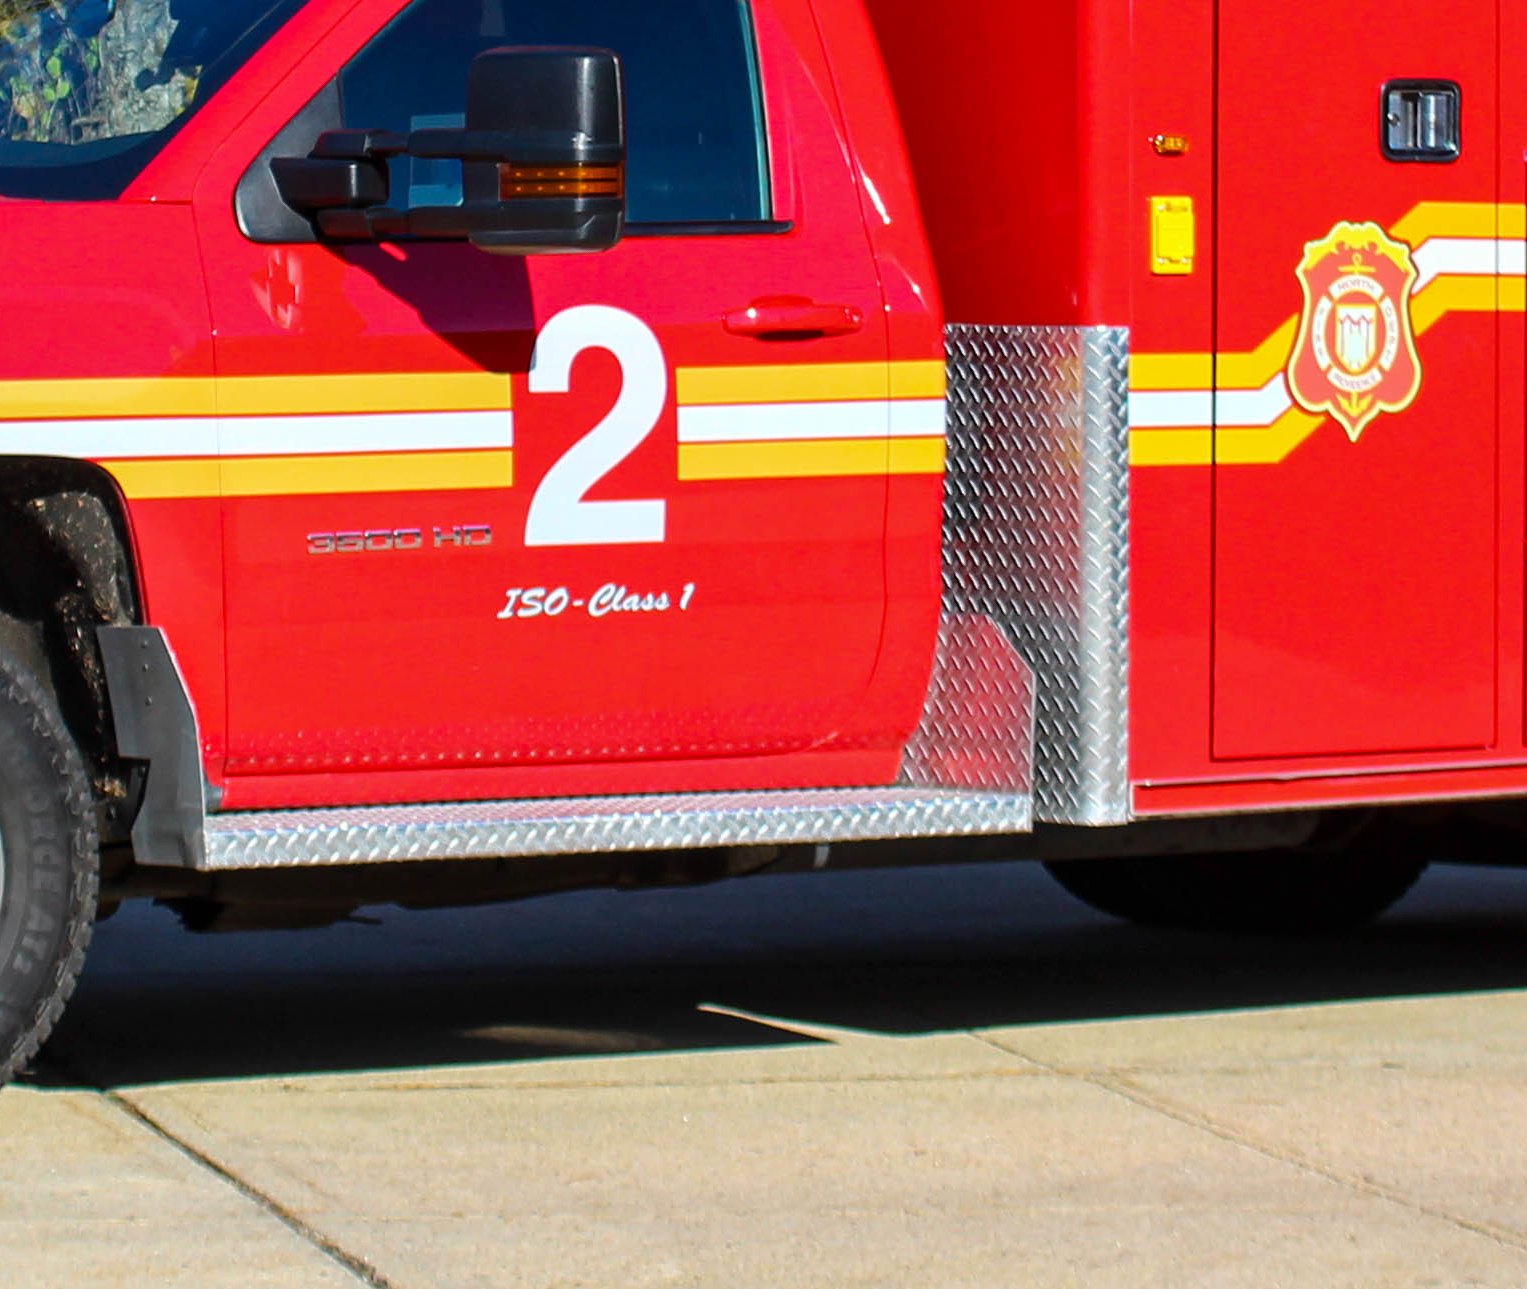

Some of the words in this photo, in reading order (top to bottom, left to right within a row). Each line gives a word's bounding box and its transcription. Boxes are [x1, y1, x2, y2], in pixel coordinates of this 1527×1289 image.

[524, 304, 668, 547] 2
[306, 528, 423, 555] 3500
[433, 524, 493, 548] HD
[678, 583, 695, 611] 1
